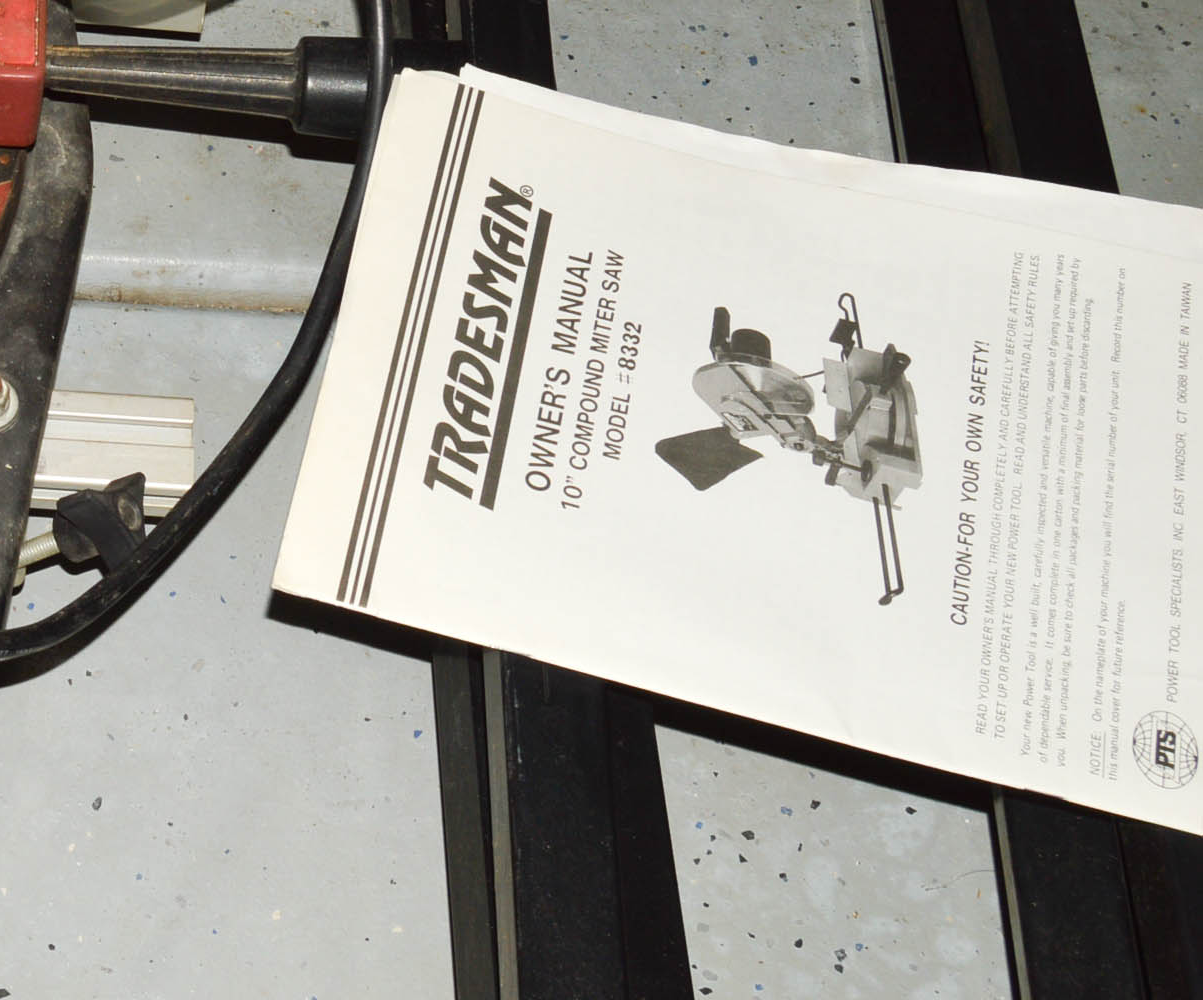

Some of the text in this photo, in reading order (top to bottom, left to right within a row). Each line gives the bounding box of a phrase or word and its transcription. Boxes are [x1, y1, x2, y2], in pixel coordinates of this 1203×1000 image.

[601, 249, 624, 293] SAW
[1026, 289, 1037, 328] SAFETY
[1181, 282, 1191, 319] TAIWAN
[589, 297, 616, 354] MITER
[1024, 330, 1034, 350] ALL
[1181, 325, 1190, 335] IN
[1112, 332, 1122, 362] Record
[1179, 340, 1189, 369] MADE
[524, 251, 593, 491] OWNER'S MANUAL
[1019, 353, 1032, 419] UNDERSTAND
[568, 358, 604, 470] COMPOUND
[602, 393, 630, 460] MODEL
[1177, 409, 1187, 423] CT
[1017, 422, 1027, 444] AND
[1015, 446, 1025, 474] READ
[950, 339, 990, 626] CAUTION-FOR YOUR OWN SAFETY!
[976, 251, 1023, 734] READ YOUR OWNER'S MANUAL THROUGH COMPLETELY AND CAREFULLY BEFORE ATTEMPTING
[1039, 473, 1048, 489] and
[1036, 492, 1050, 535] inspected
[1174, 487, 1184, 515] EAST
[1009, 513, 1020, 550] POWER
[1007, 551, 1018, 576] NEW
[1033, 536, 1047, 578] carefully
[1005, 578, 1016, 609] YOUR
[1001, 612, 1013, 663] OPERATE
[1169, 622, 1179, 652] TOOL
[999, 664, 1009, 681] OR
[1026, 650, 1036, 673] Tool
[1095, 637, 1109, 688] nameplate
[1113, 646, 1123, 676] future
[998, 684, 1008, 698] UP
[1024, 676, 1035, 706] Power
[1167, 659, 1178, 702] POWER
[996, 701, 1007, 722] SET
[1094, 688, 1104, 705] the
[1093, 705, 1103, 722] On
[995, 724, 1005, 739] TO
[1021, 733, 1031, 757] Your
[1109, 724, 1119, 759] manual
[1156, 727, 1176, 769] PTS
[1108, 762, 1117, 780] this
